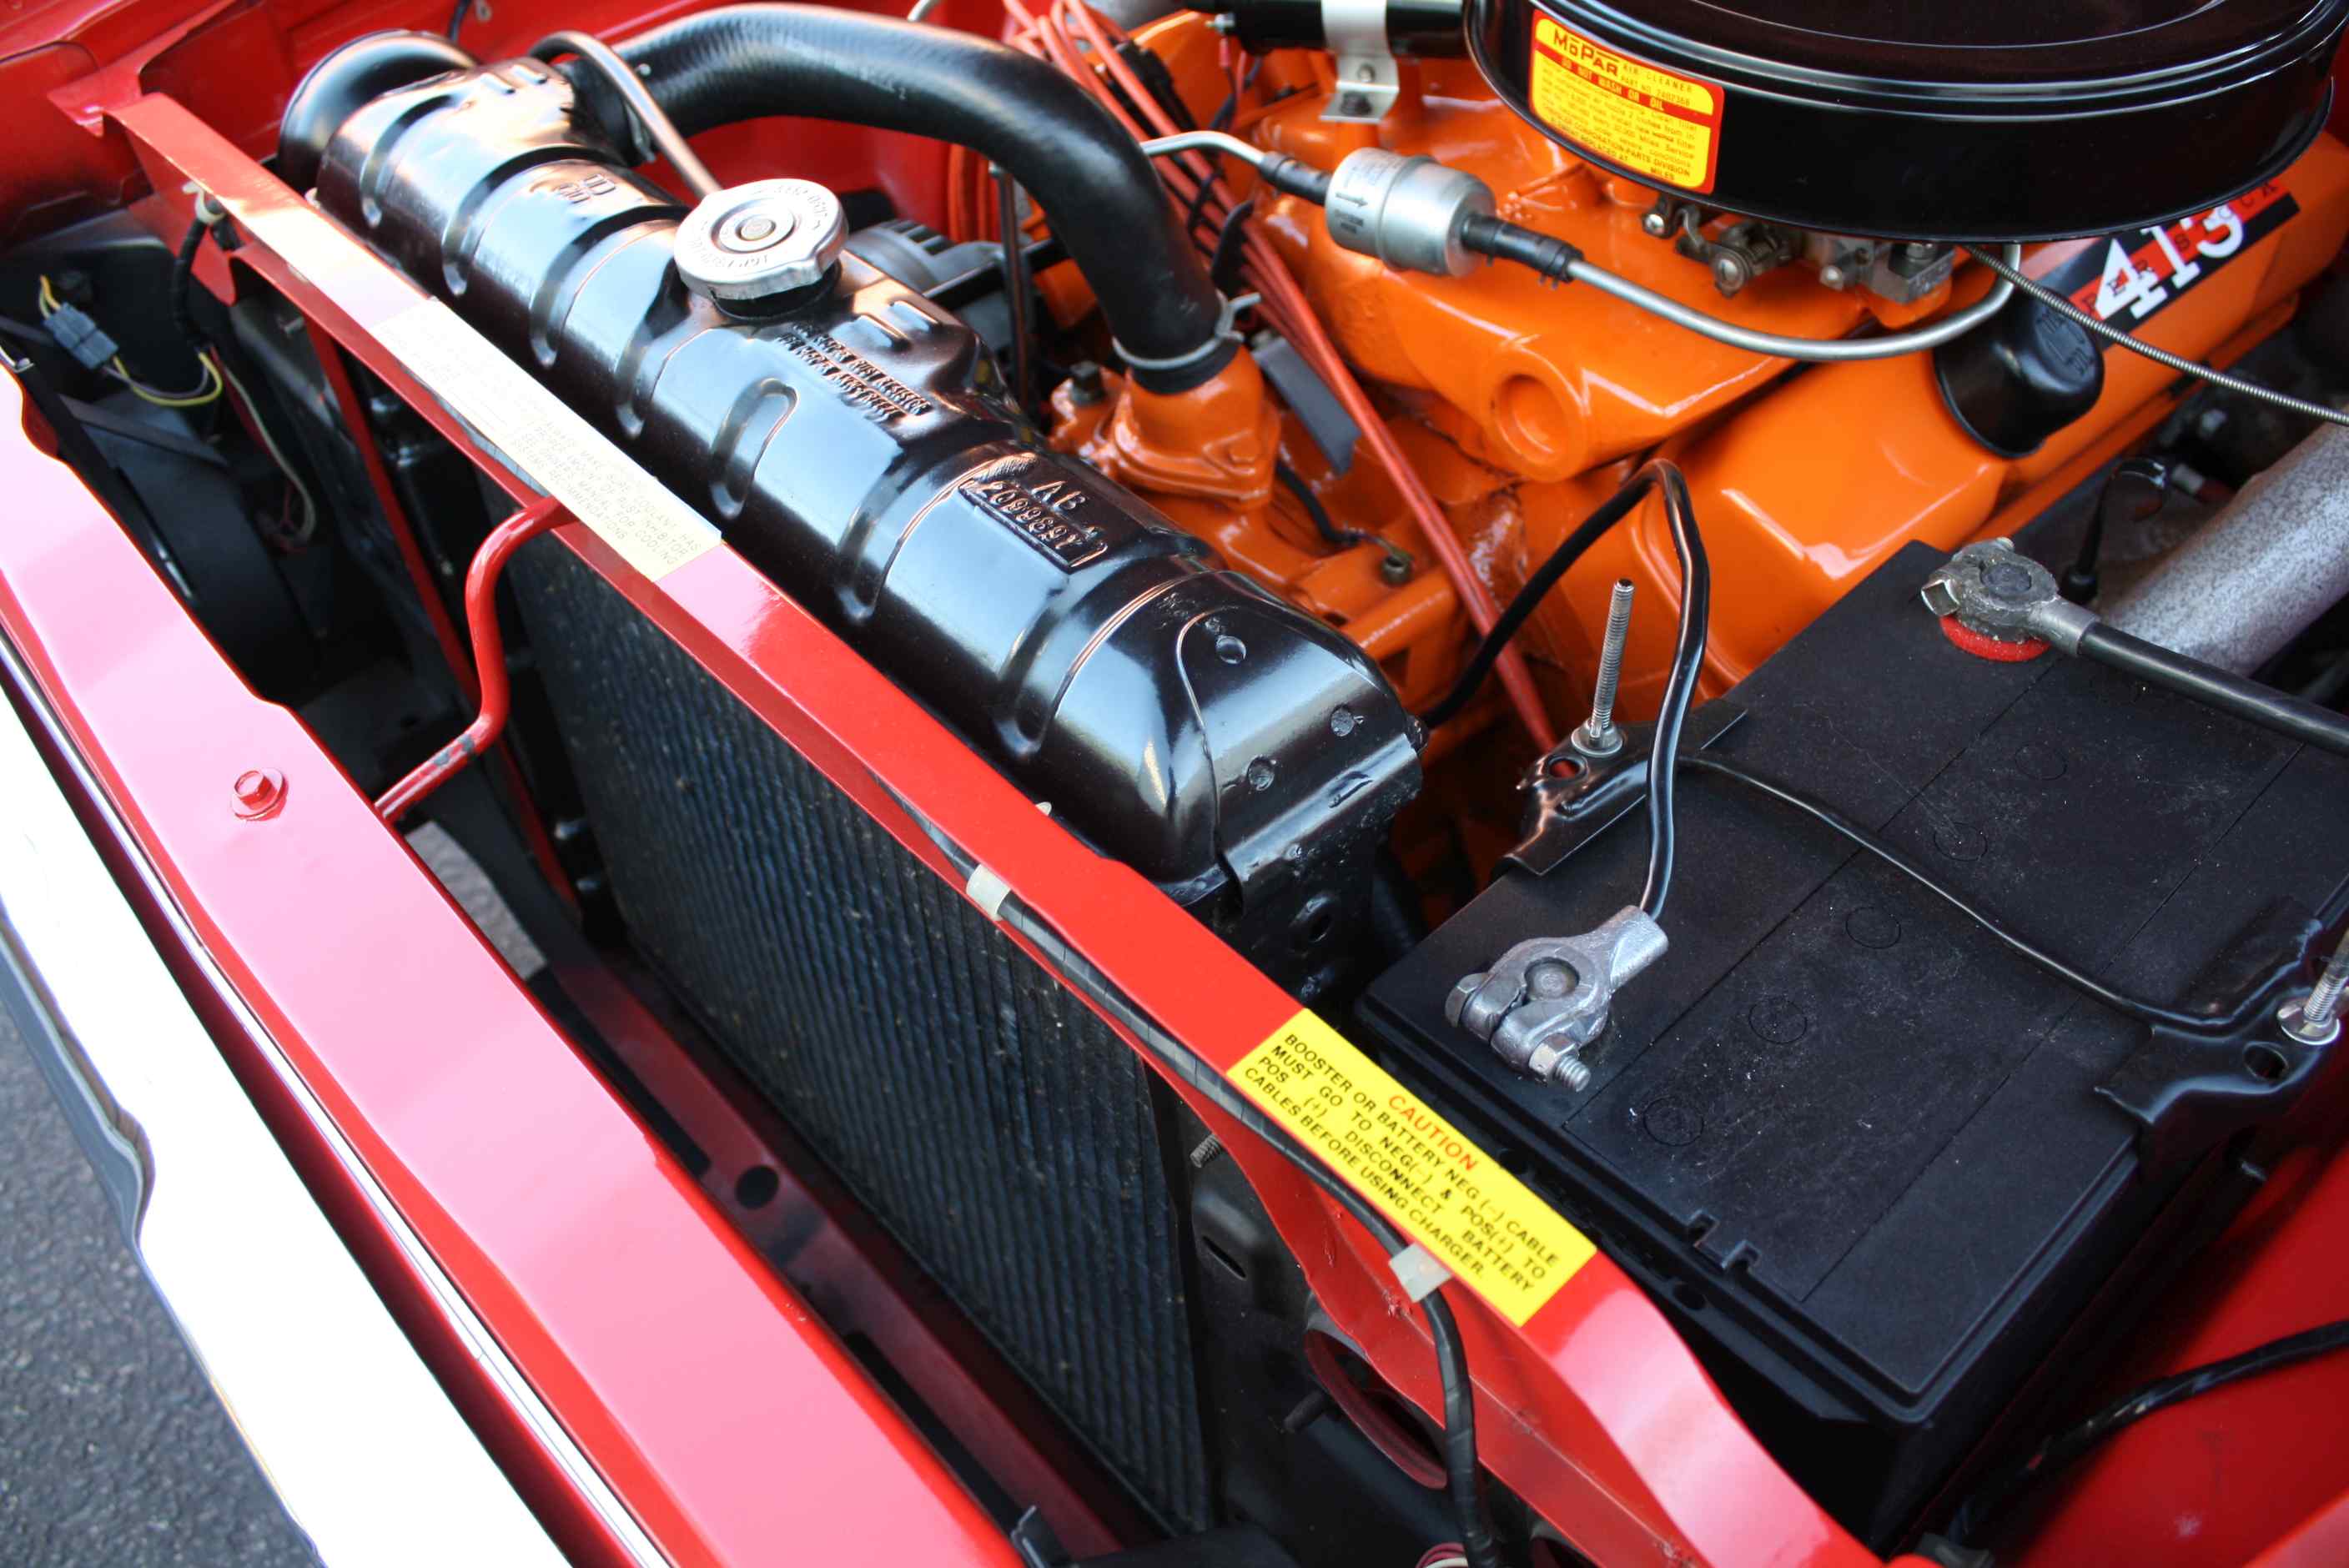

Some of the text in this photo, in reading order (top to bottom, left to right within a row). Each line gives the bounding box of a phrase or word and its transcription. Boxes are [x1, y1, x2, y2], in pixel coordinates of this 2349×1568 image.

[1598, 76, 1621, 94] WASH
[1627, 89, 1639, 101] OR
[1649, 98, 1664, 111] OIL
[1647, 72, 1692, 93] CLEANER
[2093, 204, 2244, 320] 413
[576, 480, 614, 510] MANUAL
[613, 512, 634, 528] FOR
[633, 530, 677, 565] COOLING
[615, 497, 641, 516] RUST
[641, 519, 687, 556] INHIBITOR
[634, 496, 677, 530] COOLANT
[678, 533, 702, 550] HAS
[1245, 1068, 1300, 1115] CABLES
[1300, 1114, 1360, 1167] BEFORE
[1360, 1166, 1408, 1209] USING
[1258, 1056, 1532, 1289] POS (+) DISCONNECT BATTERY
[1271, 1045, 1313, 1079] MUST
[1319, 1085, 1343, 1106] GO
[1351, 1110, 1371, 1131] TO
[1439, 1188, 1451, 1199] &
[1523, 1256, 1545, 1278] TO
[1285, 1034, 1352, 1092] BOOSTER
[1353, 1092, 1376, 1112] OR
[1376, 1111, 1443, 1167] BATTERY
[1445, 1168, 1479, 1199] NEG
[1506, 1220, 1557, 1264] CABLE
[1389, 1095, 1477, 1170] CAUTION
